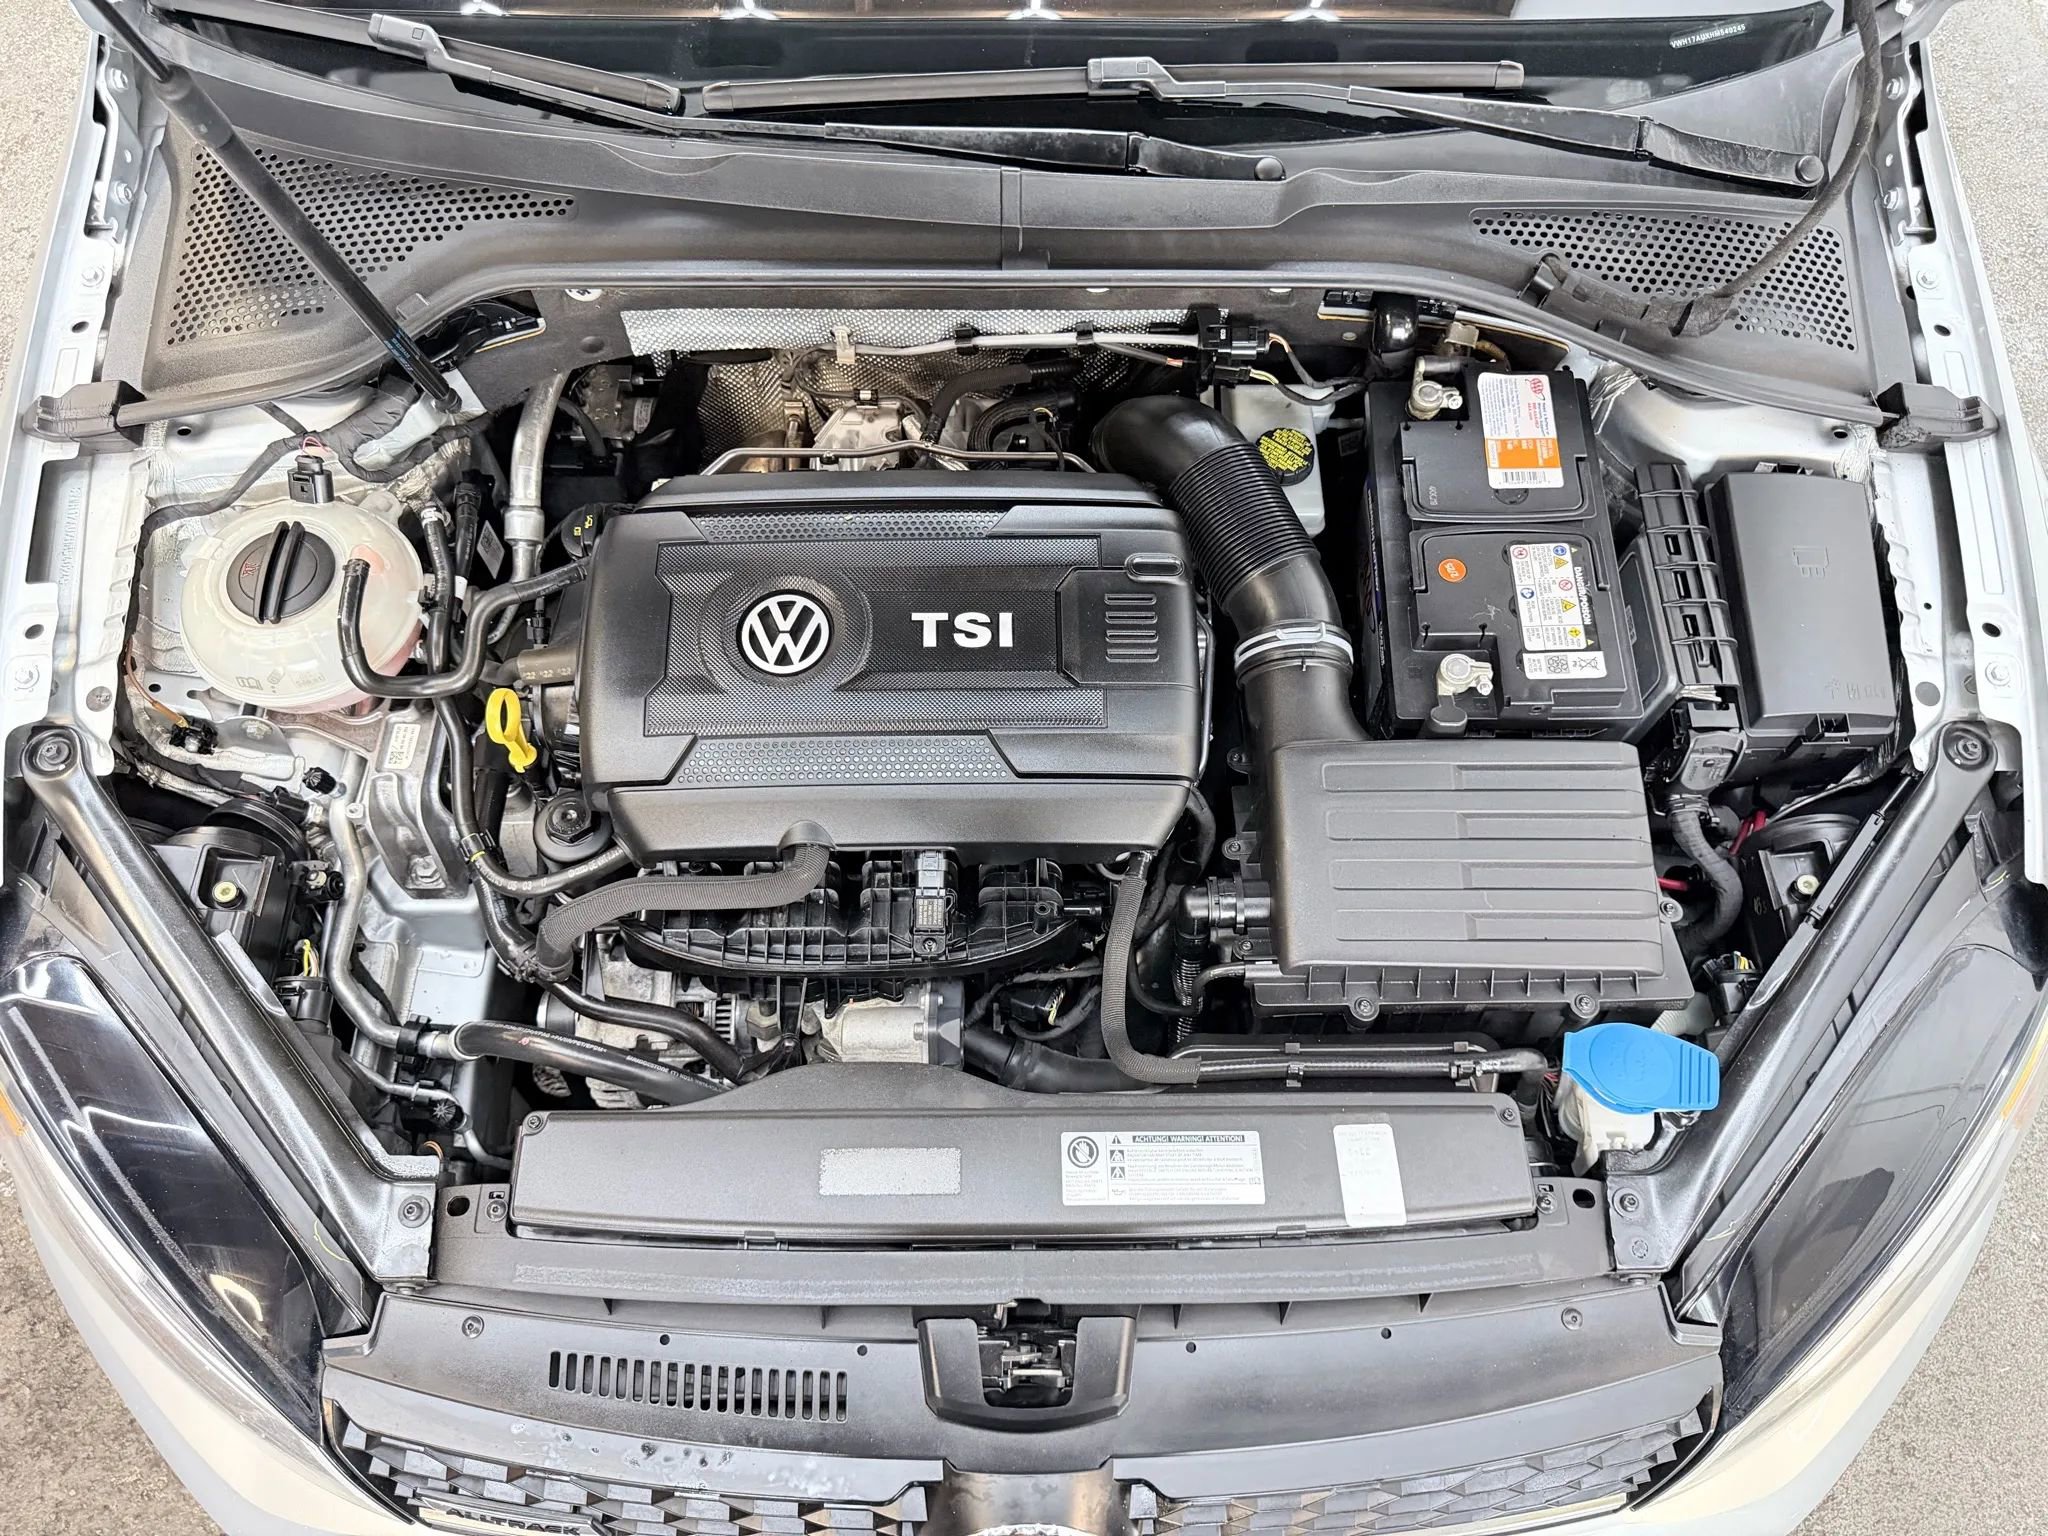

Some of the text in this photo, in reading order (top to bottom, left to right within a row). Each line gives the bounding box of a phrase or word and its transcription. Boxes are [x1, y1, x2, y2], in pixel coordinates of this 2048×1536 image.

[1574, 566, 1592, 625] DANGER/POISON
[911, 612, 1013, 648] TSI
[1134, 1135, 1243, 1143] ACHTUNG! WARNING! ATTENTION!
[446, 1507, 581, 1536] ALLTRACK
